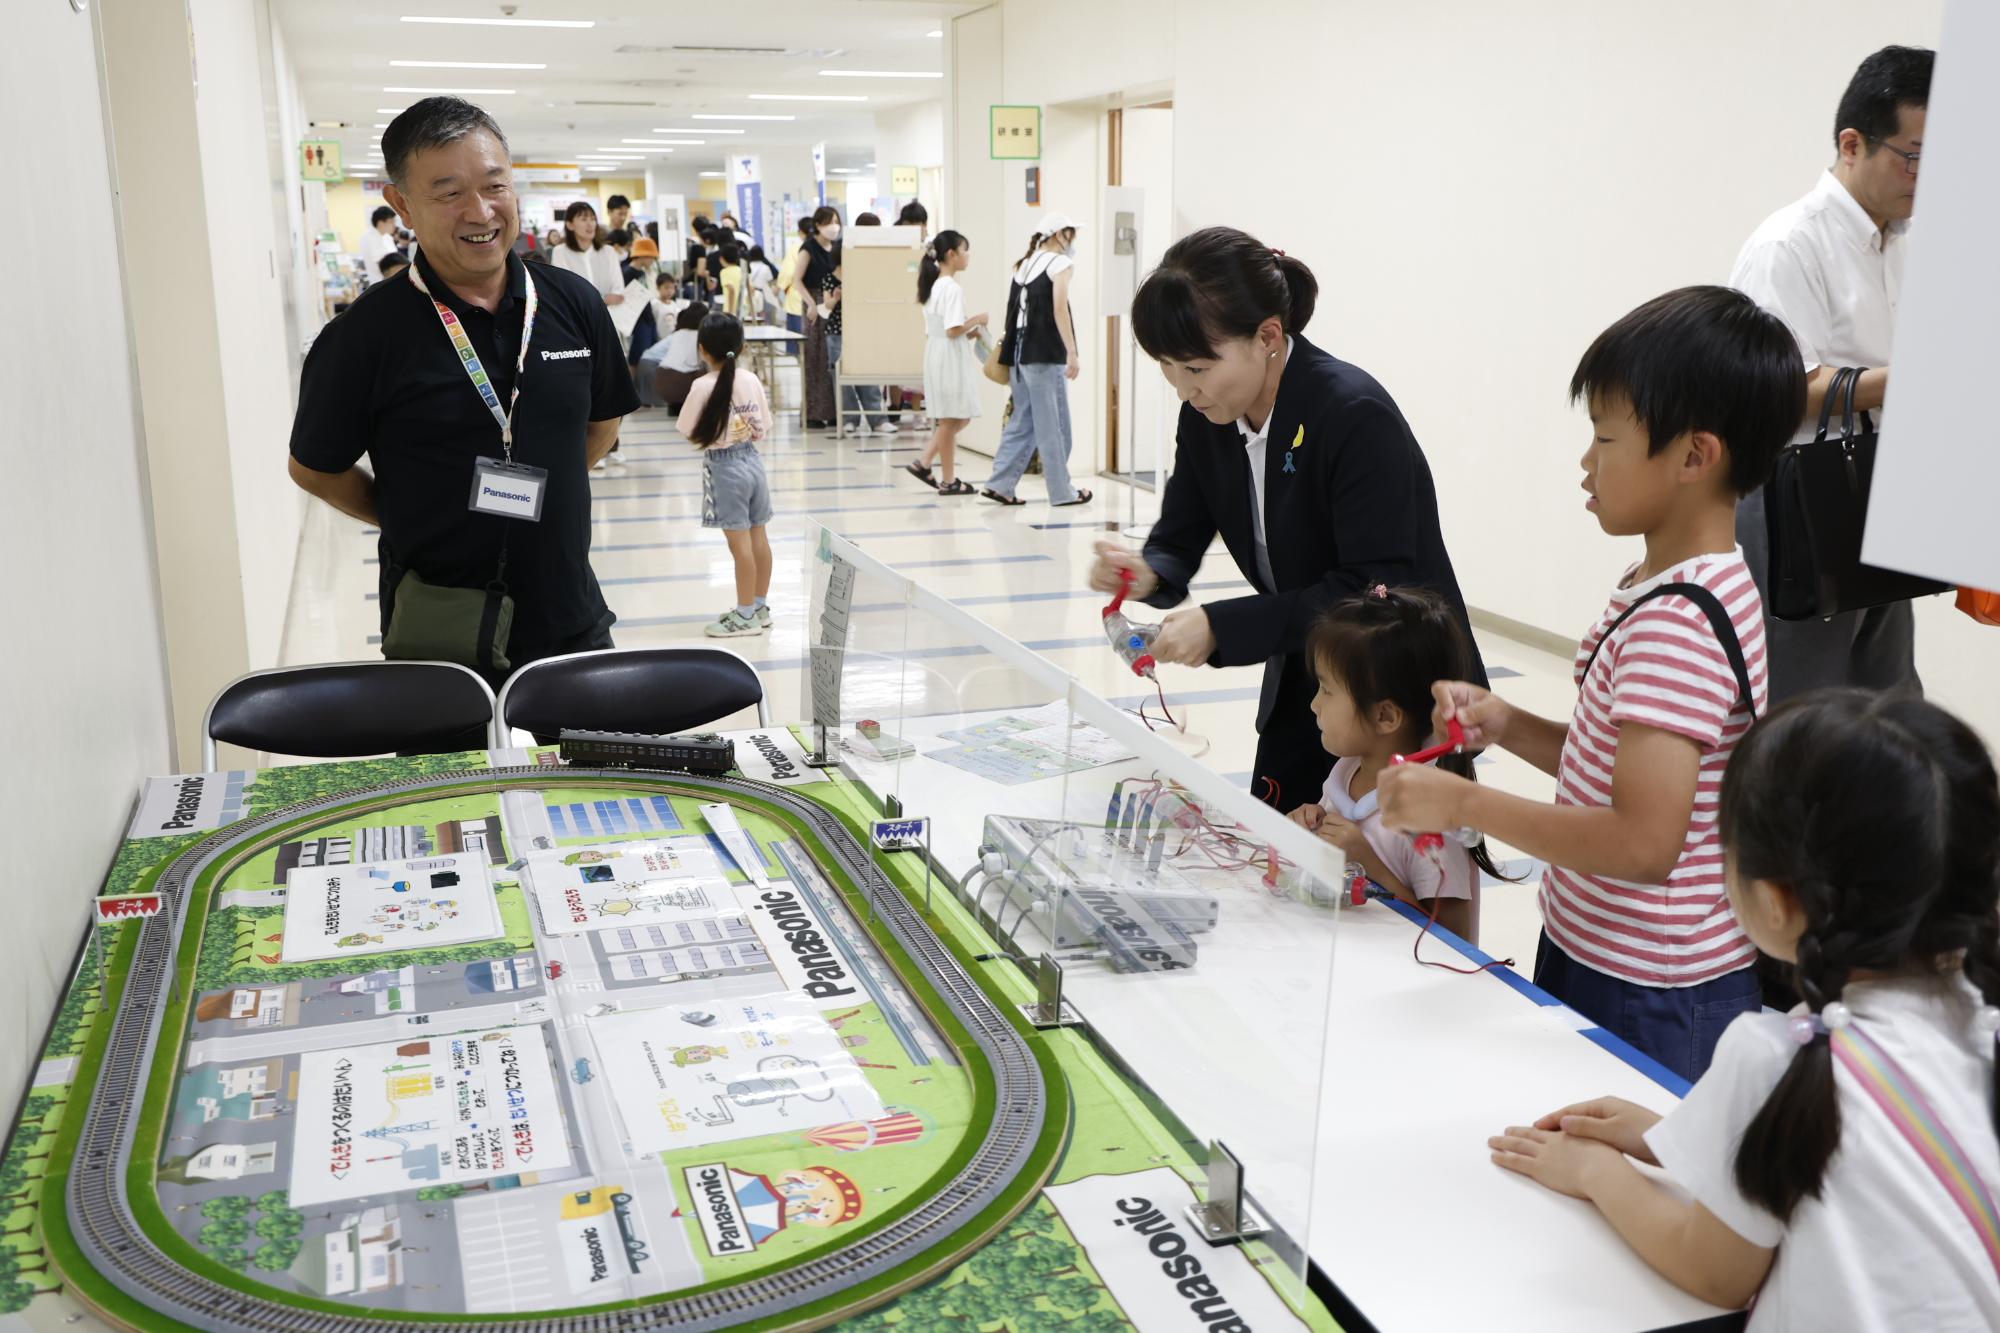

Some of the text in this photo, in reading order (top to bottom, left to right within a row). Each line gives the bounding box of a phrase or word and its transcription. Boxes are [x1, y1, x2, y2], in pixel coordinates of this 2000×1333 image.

[541, 347, 591, 361] Panasonic
[483, 487, 531, 502] Panasonic
[746, 734, 799, 780] Panasonic
[161, 776, 204, 832] Panasonic
[887, 822, 913, 832] スタート
[117, 900, 144, 909] ゴール
[754, 889, 857, 999] Panasonic
[696, 1168, 745, 1252] Panasonic
[581, 1227, 608, 1283] Panasonic
[1114, 1197, 1252, 1333] anasonic
